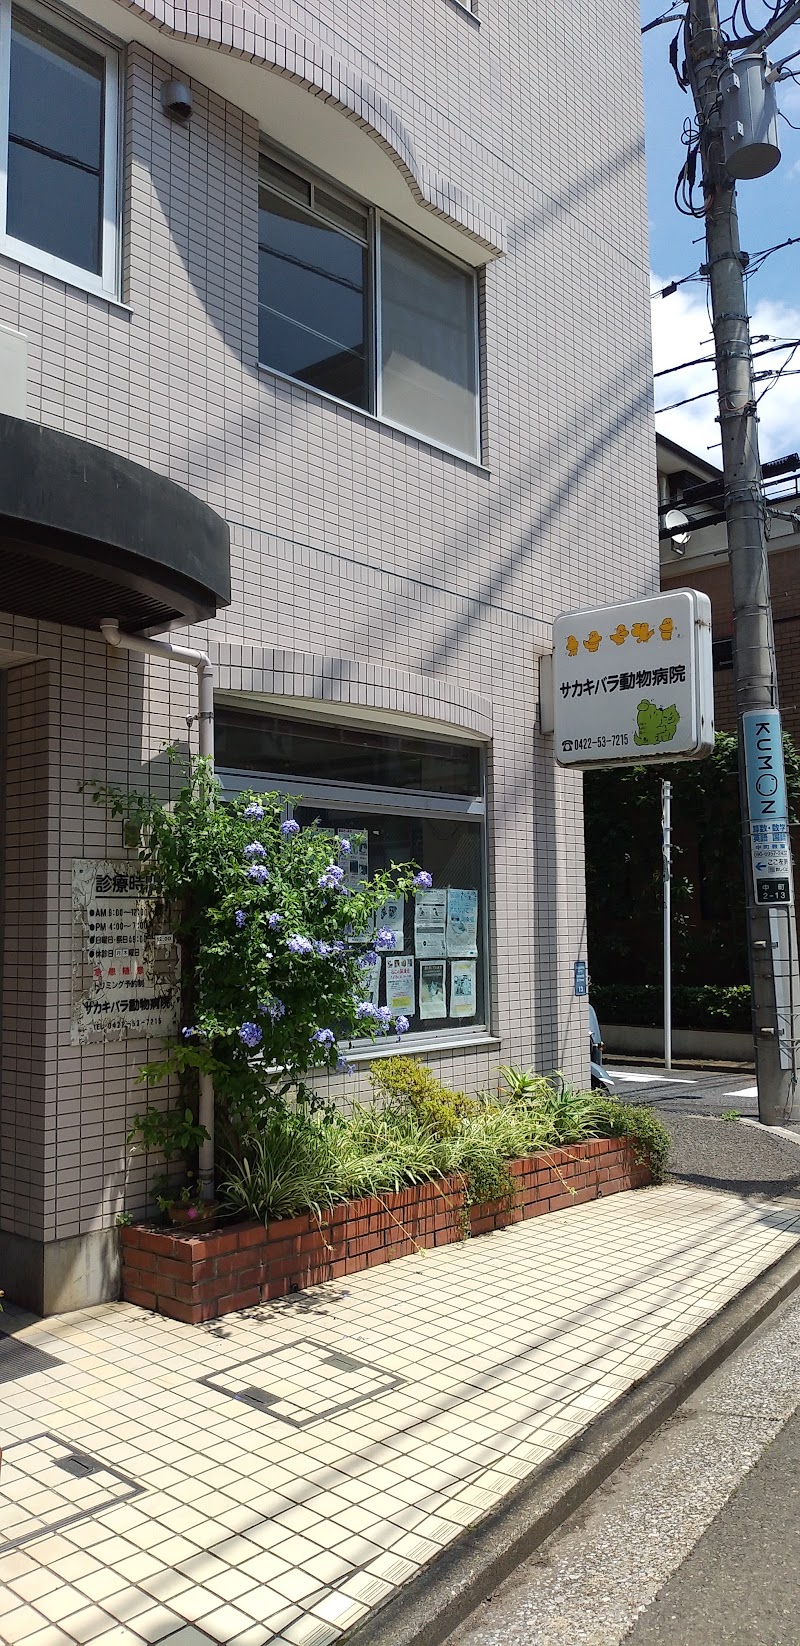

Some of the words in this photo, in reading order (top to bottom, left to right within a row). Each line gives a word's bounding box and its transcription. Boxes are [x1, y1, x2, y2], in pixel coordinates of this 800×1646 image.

[560, 665, 686, 699] サカキバラ動物病院
[574, 734, 629, 750] 0422-53-7215
[755, 722, 777, 814] KUMON
[95, 909, 107, 917] AM
[95, 923, 106, 931] PM
